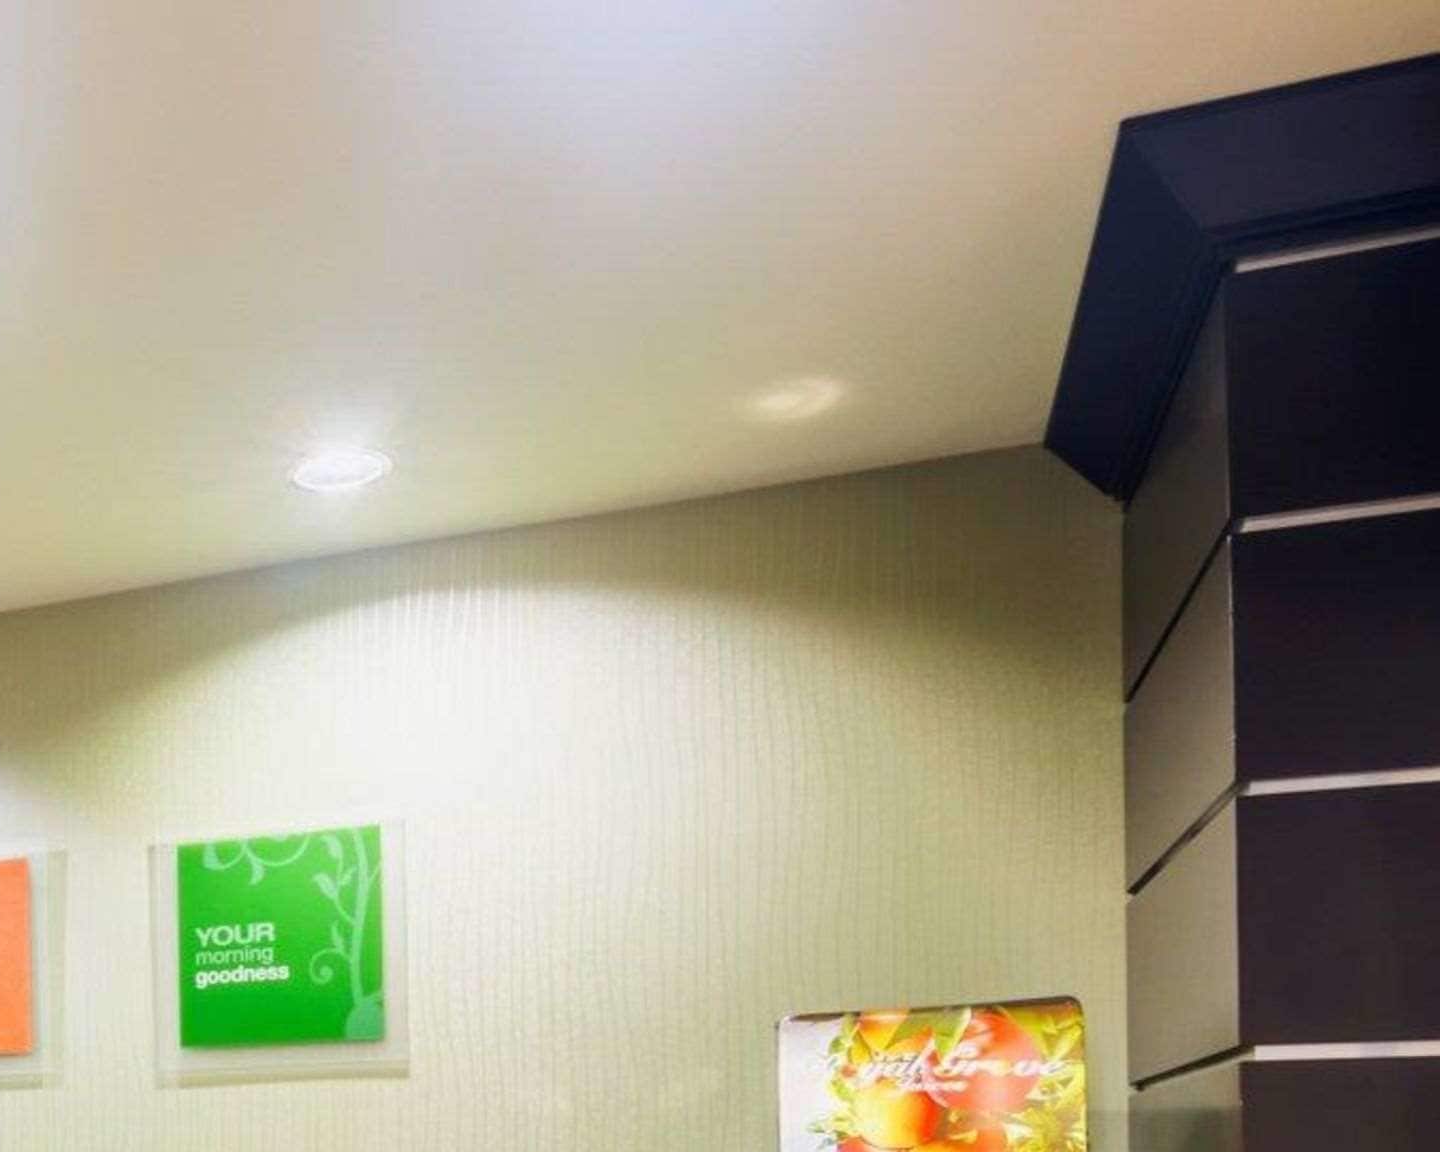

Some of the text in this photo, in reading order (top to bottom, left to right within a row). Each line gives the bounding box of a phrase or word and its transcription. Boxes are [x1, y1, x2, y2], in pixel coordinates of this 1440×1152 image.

[195, 922, 275, 947] YOUR
[195, 945, 274, 966] morning
[195, 964, 290, 989] goodness
